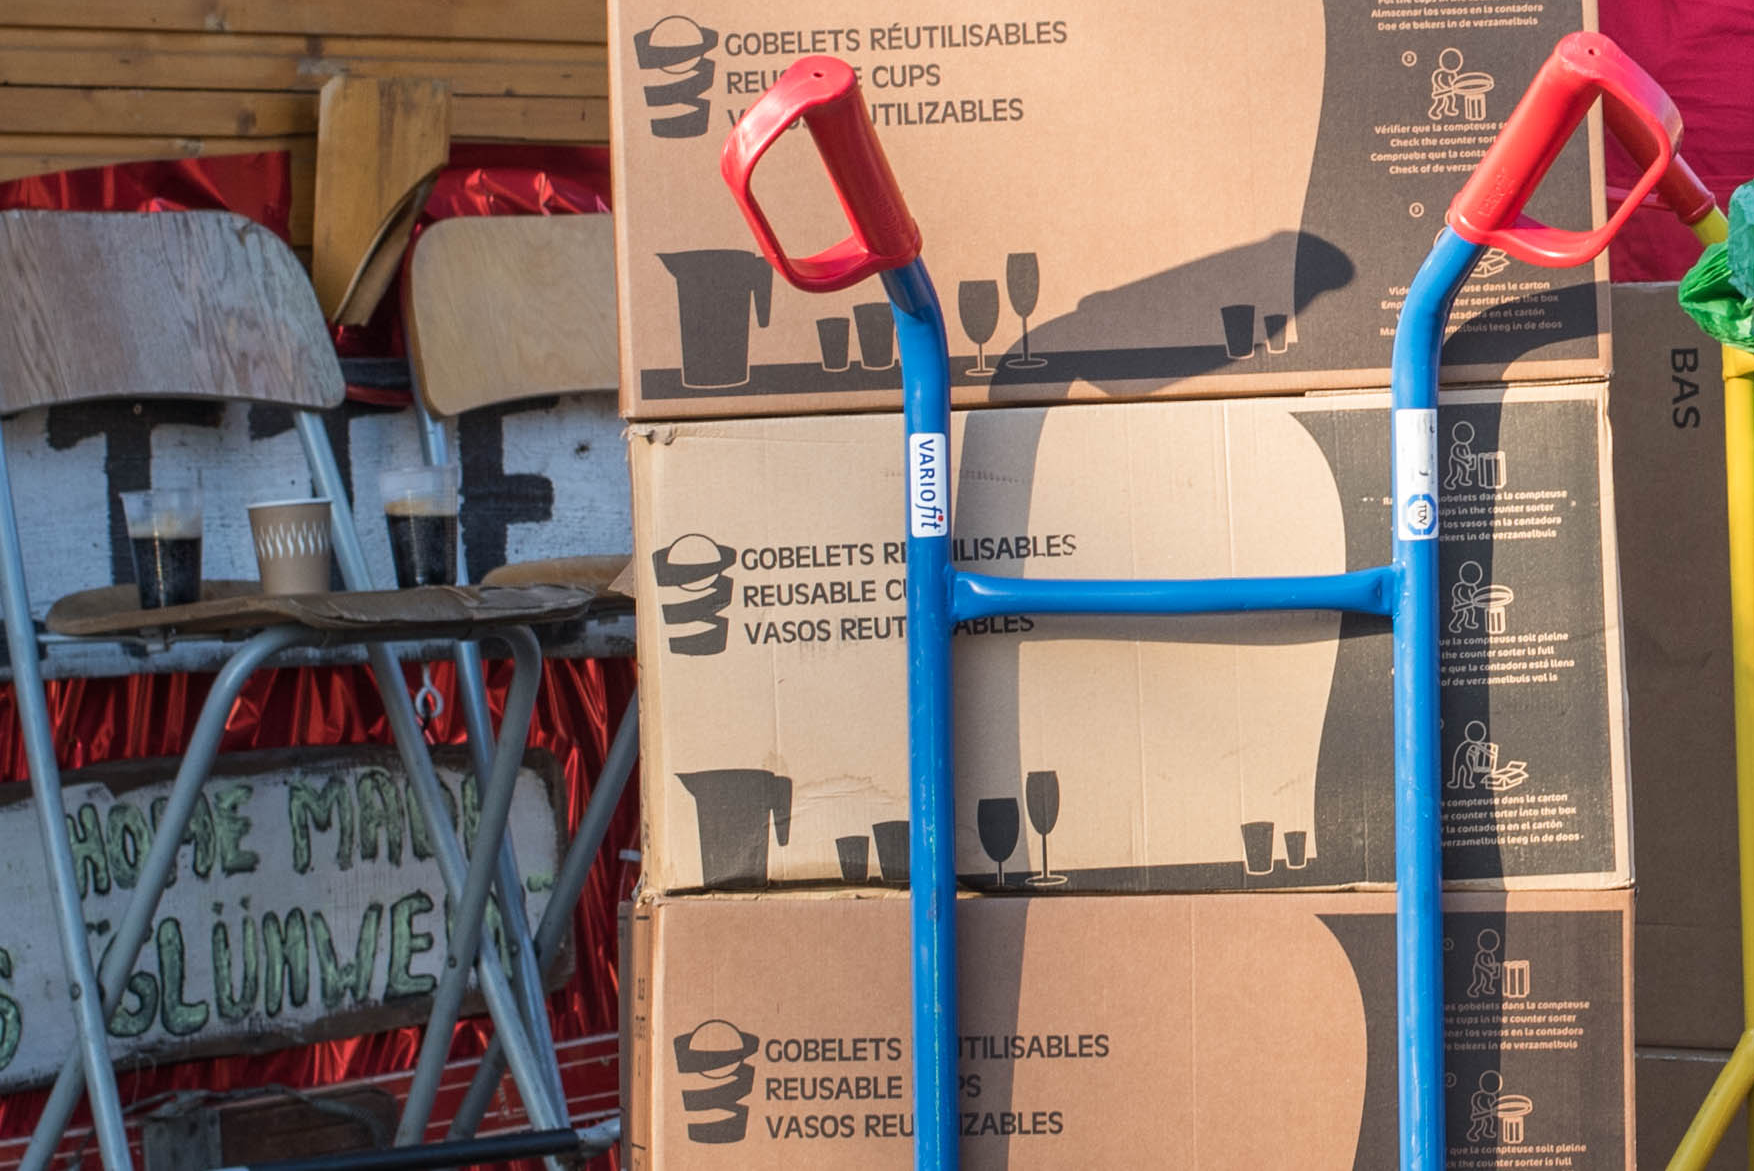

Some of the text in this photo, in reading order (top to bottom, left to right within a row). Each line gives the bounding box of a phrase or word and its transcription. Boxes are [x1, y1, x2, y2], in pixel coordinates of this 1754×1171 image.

[1371, 9, 1422, 17] Almacenar
[1423, 7, 1438, 16] los
[1483, 5, 1493, 14] la
[1495, 4, 1544, 13] contadora
[1398, 21, 1411, 29] de
[1413, 20, 1445, 29] bekers
[1447, 19, 1457, 28] in
[1459, 19, 1471, 27] de
[1473, 16, 1538, 27] verzamelbuis
[725, 21, 1067, 56] GOBELETS RÉUTILISABLES
[872, 64, 941, 89] CUPS
[1374, 124, 1411, 134] Vérifier
[1412, 125, 1431, 135] que
[1432, 123, 1442, 132] la
[1443, 123, 1497, 133] compteuse
[1390, 136, 1476, 147] Check the counter
[1428, 152, 1447, 161] que
[1448, 150, 1458, 158] la
[1389, 165, 1419, 174] Check
[1421, 165, 1431, 173] of
[1432, 164, 1445, 173] de
[1483, 284, 1506, 292] dans
[1470, 298, 1499, 306] sorter
[1670, 347, 1701, 429] BAS
[914, 438, 944, 530] VARIOfit
[1479, 492, 1567, 502] dans compteuse
[1470, 504, 1554, 514] the counter sorter
[1443, 520, 1459, 528] los
[1514, 516, 1562, 525] contadora
[1492, 529, 1557, 539] verzamelbuis
[741, 543, 874, 571] GOBELETS
[743, 580, 876, 608] REUSABLE
[744, 616, 1034, 645] VASOS REUTABLES
[1464, 632, 1569, 646] compteuse soit pleine
[1441, 645, 1554, 659] the counter sorter full
[1448, 658, 1575, 674] que contadora está llena
[1466, 673, 1558, 685] verzamelbuis vol is
[1447, 794, 1568, 808] compteuse dans le carton
[1451, 806, 1576, 819] counter sorter into the box
[1447, 825, 1456, 833] la
[1458, 823, 1505, 833] contadora
[1520, 821, 1530, 830] el
[1532, 819, 1563, 829] cartón
[66, 784, 259, 896] HOME
[1507, 835, 1528, 845] leeg
[1530, 834, 1540, 843] in
[1542, 834, 1554, 842] de
[765, 1038, 902, 1062] GOBELETS
[765, 1076, 903, 1101] REUSABLE
[765, 1110, 1064, 1139] VASOS REUIZABLES
